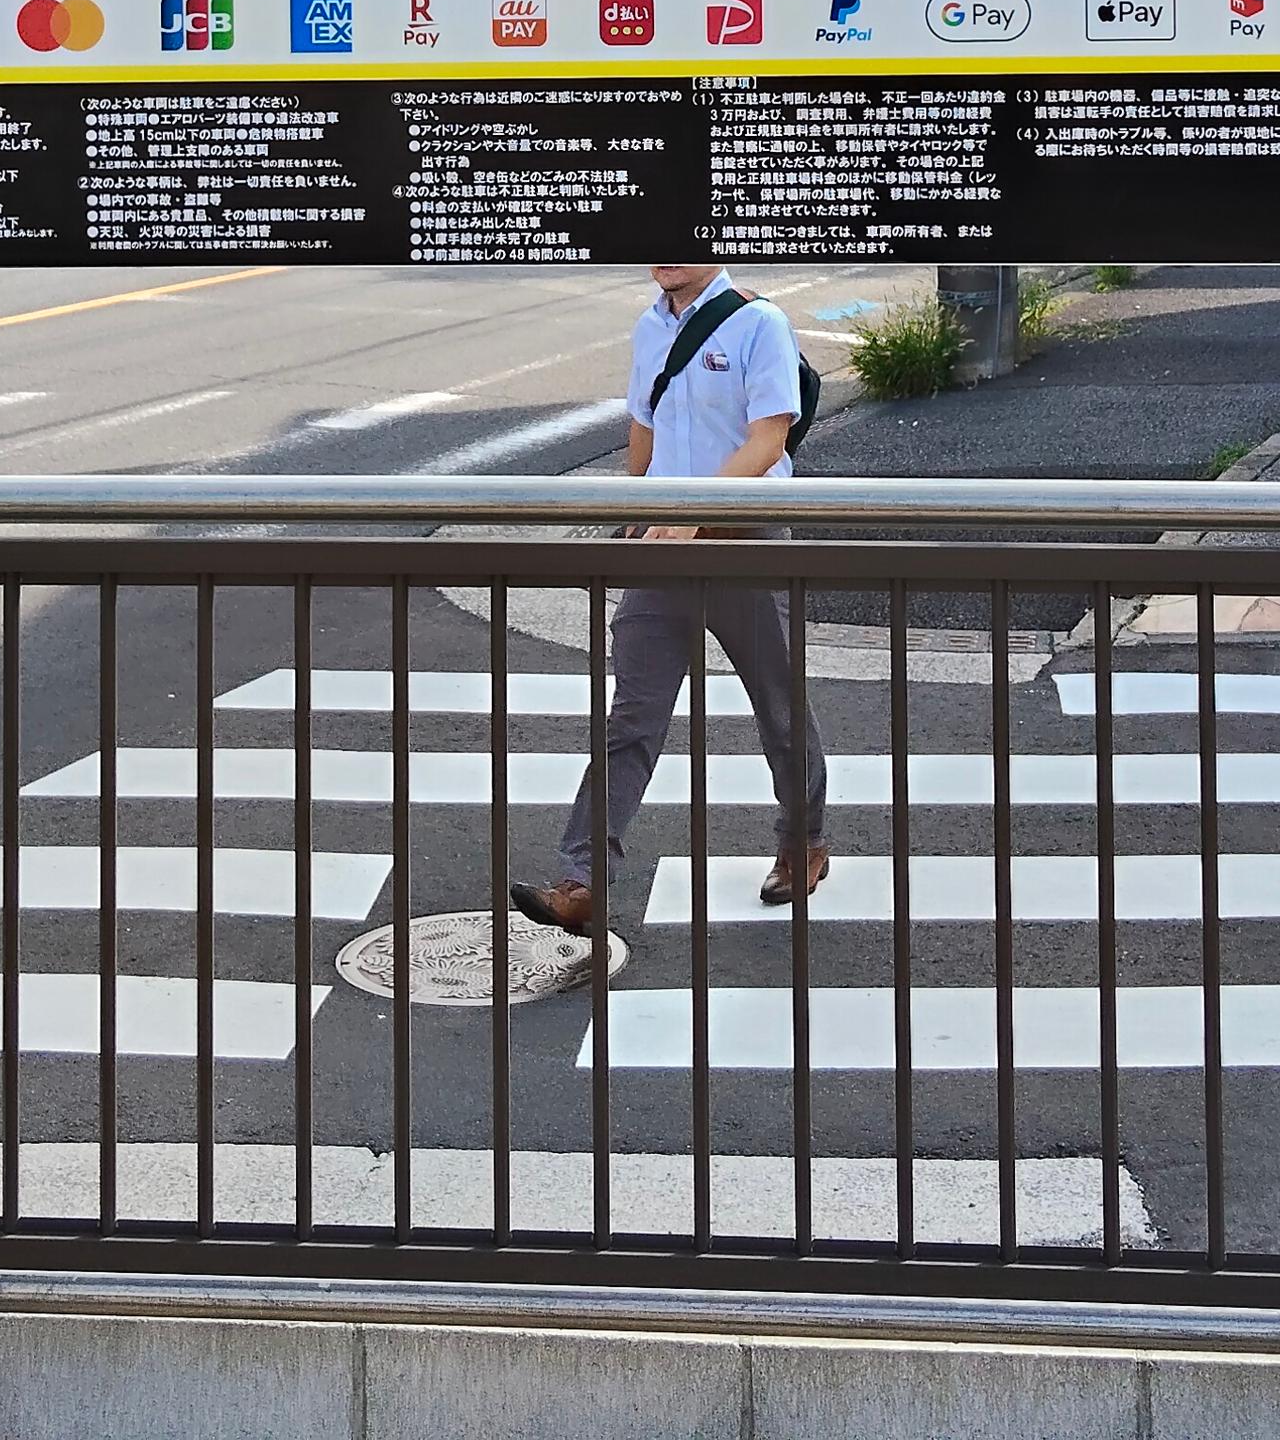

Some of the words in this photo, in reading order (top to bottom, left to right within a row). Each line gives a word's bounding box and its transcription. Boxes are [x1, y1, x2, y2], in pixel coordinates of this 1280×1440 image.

[500, 0, 538, 17] au
[605, 3, 650, 21] d払い
[973, 4, 1014, 30] Pay
[1119, 1, 1163, 27] Pay
[502, 20, 538, 39] PAY
[816, 27, 872, 44] PayPal
[1231, 20, 1264, 38] Pay
[404, 31, 439, 48] Pay
